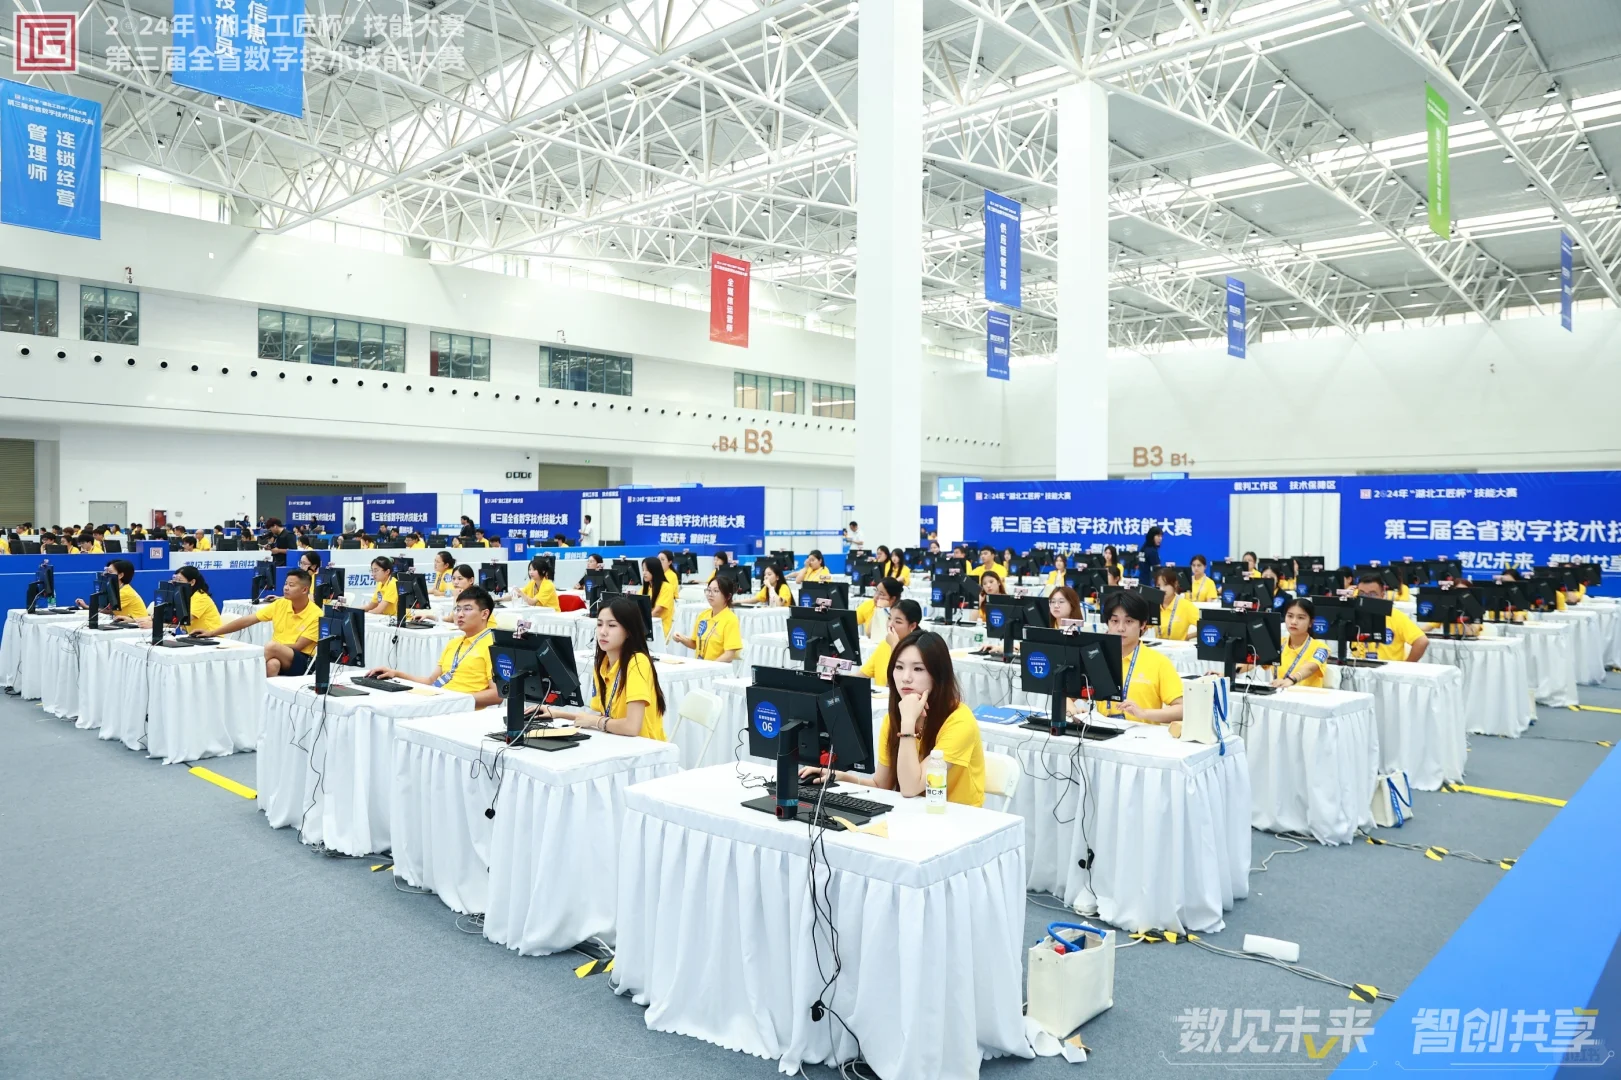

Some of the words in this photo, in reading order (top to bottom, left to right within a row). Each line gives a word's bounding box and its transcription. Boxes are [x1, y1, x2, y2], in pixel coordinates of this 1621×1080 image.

[247, 0, 268, 46] 信息
[27, 123, 48, 182] 管理师
[56, 129, 76, 208] 连锁经营
[719, 435, 738, 452] B4
[744, 428, 773, 454] B3
[1133, 445, 1164, 467] B3
[1171, 452, 1187, 467] B1
[490, 513, 569, 526] 第三届全省数字技术技能大赛
[636, 513, 745, 529] 第三届全省数字技术技能大赛
[990, 516, 1193, 537] 第三届全省数字技术技能大赛
[796, 638, 804, 647] 11
[502, 669, 511, 677] 05
[1034, 665, 1044, 674] 12
[762, 721, 773, 732] 06
